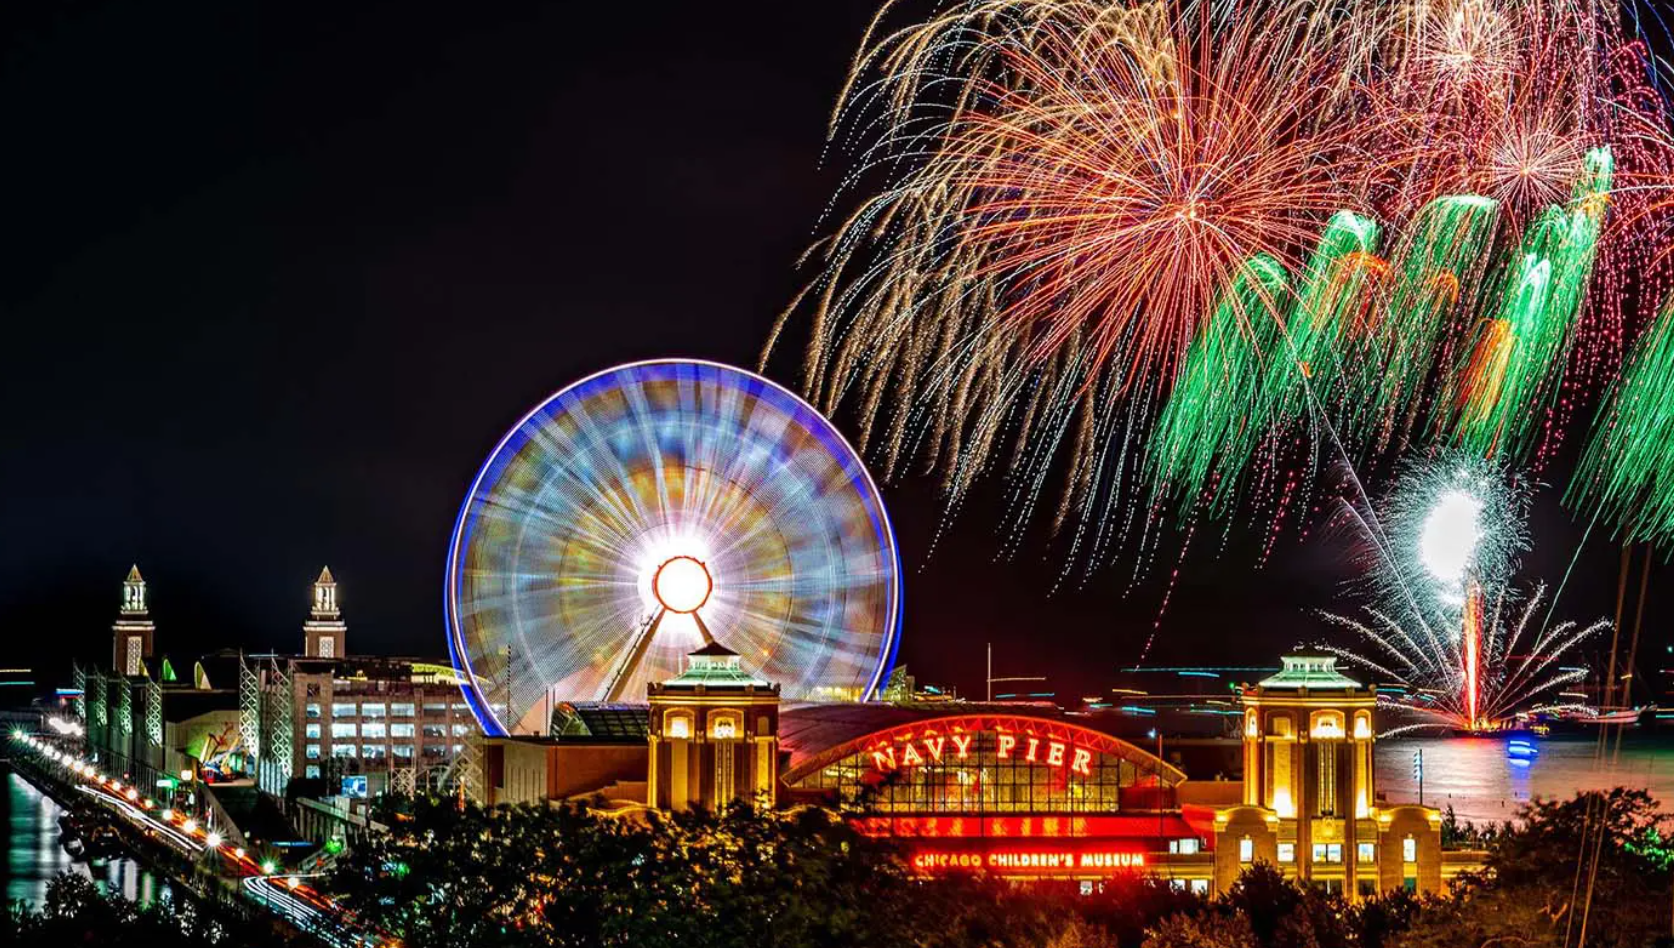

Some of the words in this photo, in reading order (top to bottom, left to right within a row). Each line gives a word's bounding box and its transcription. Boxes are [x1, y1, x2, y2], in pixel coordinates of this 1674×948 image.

[872, 735, 971, 771] NAVY
[997, 734, 1092, 775] PIER
[915, 854, 982, 867] CHICAGO
[988, 853, 1074, 867] CHILDREN'S
[1081, 853, 1145, 867] MUSEUM
